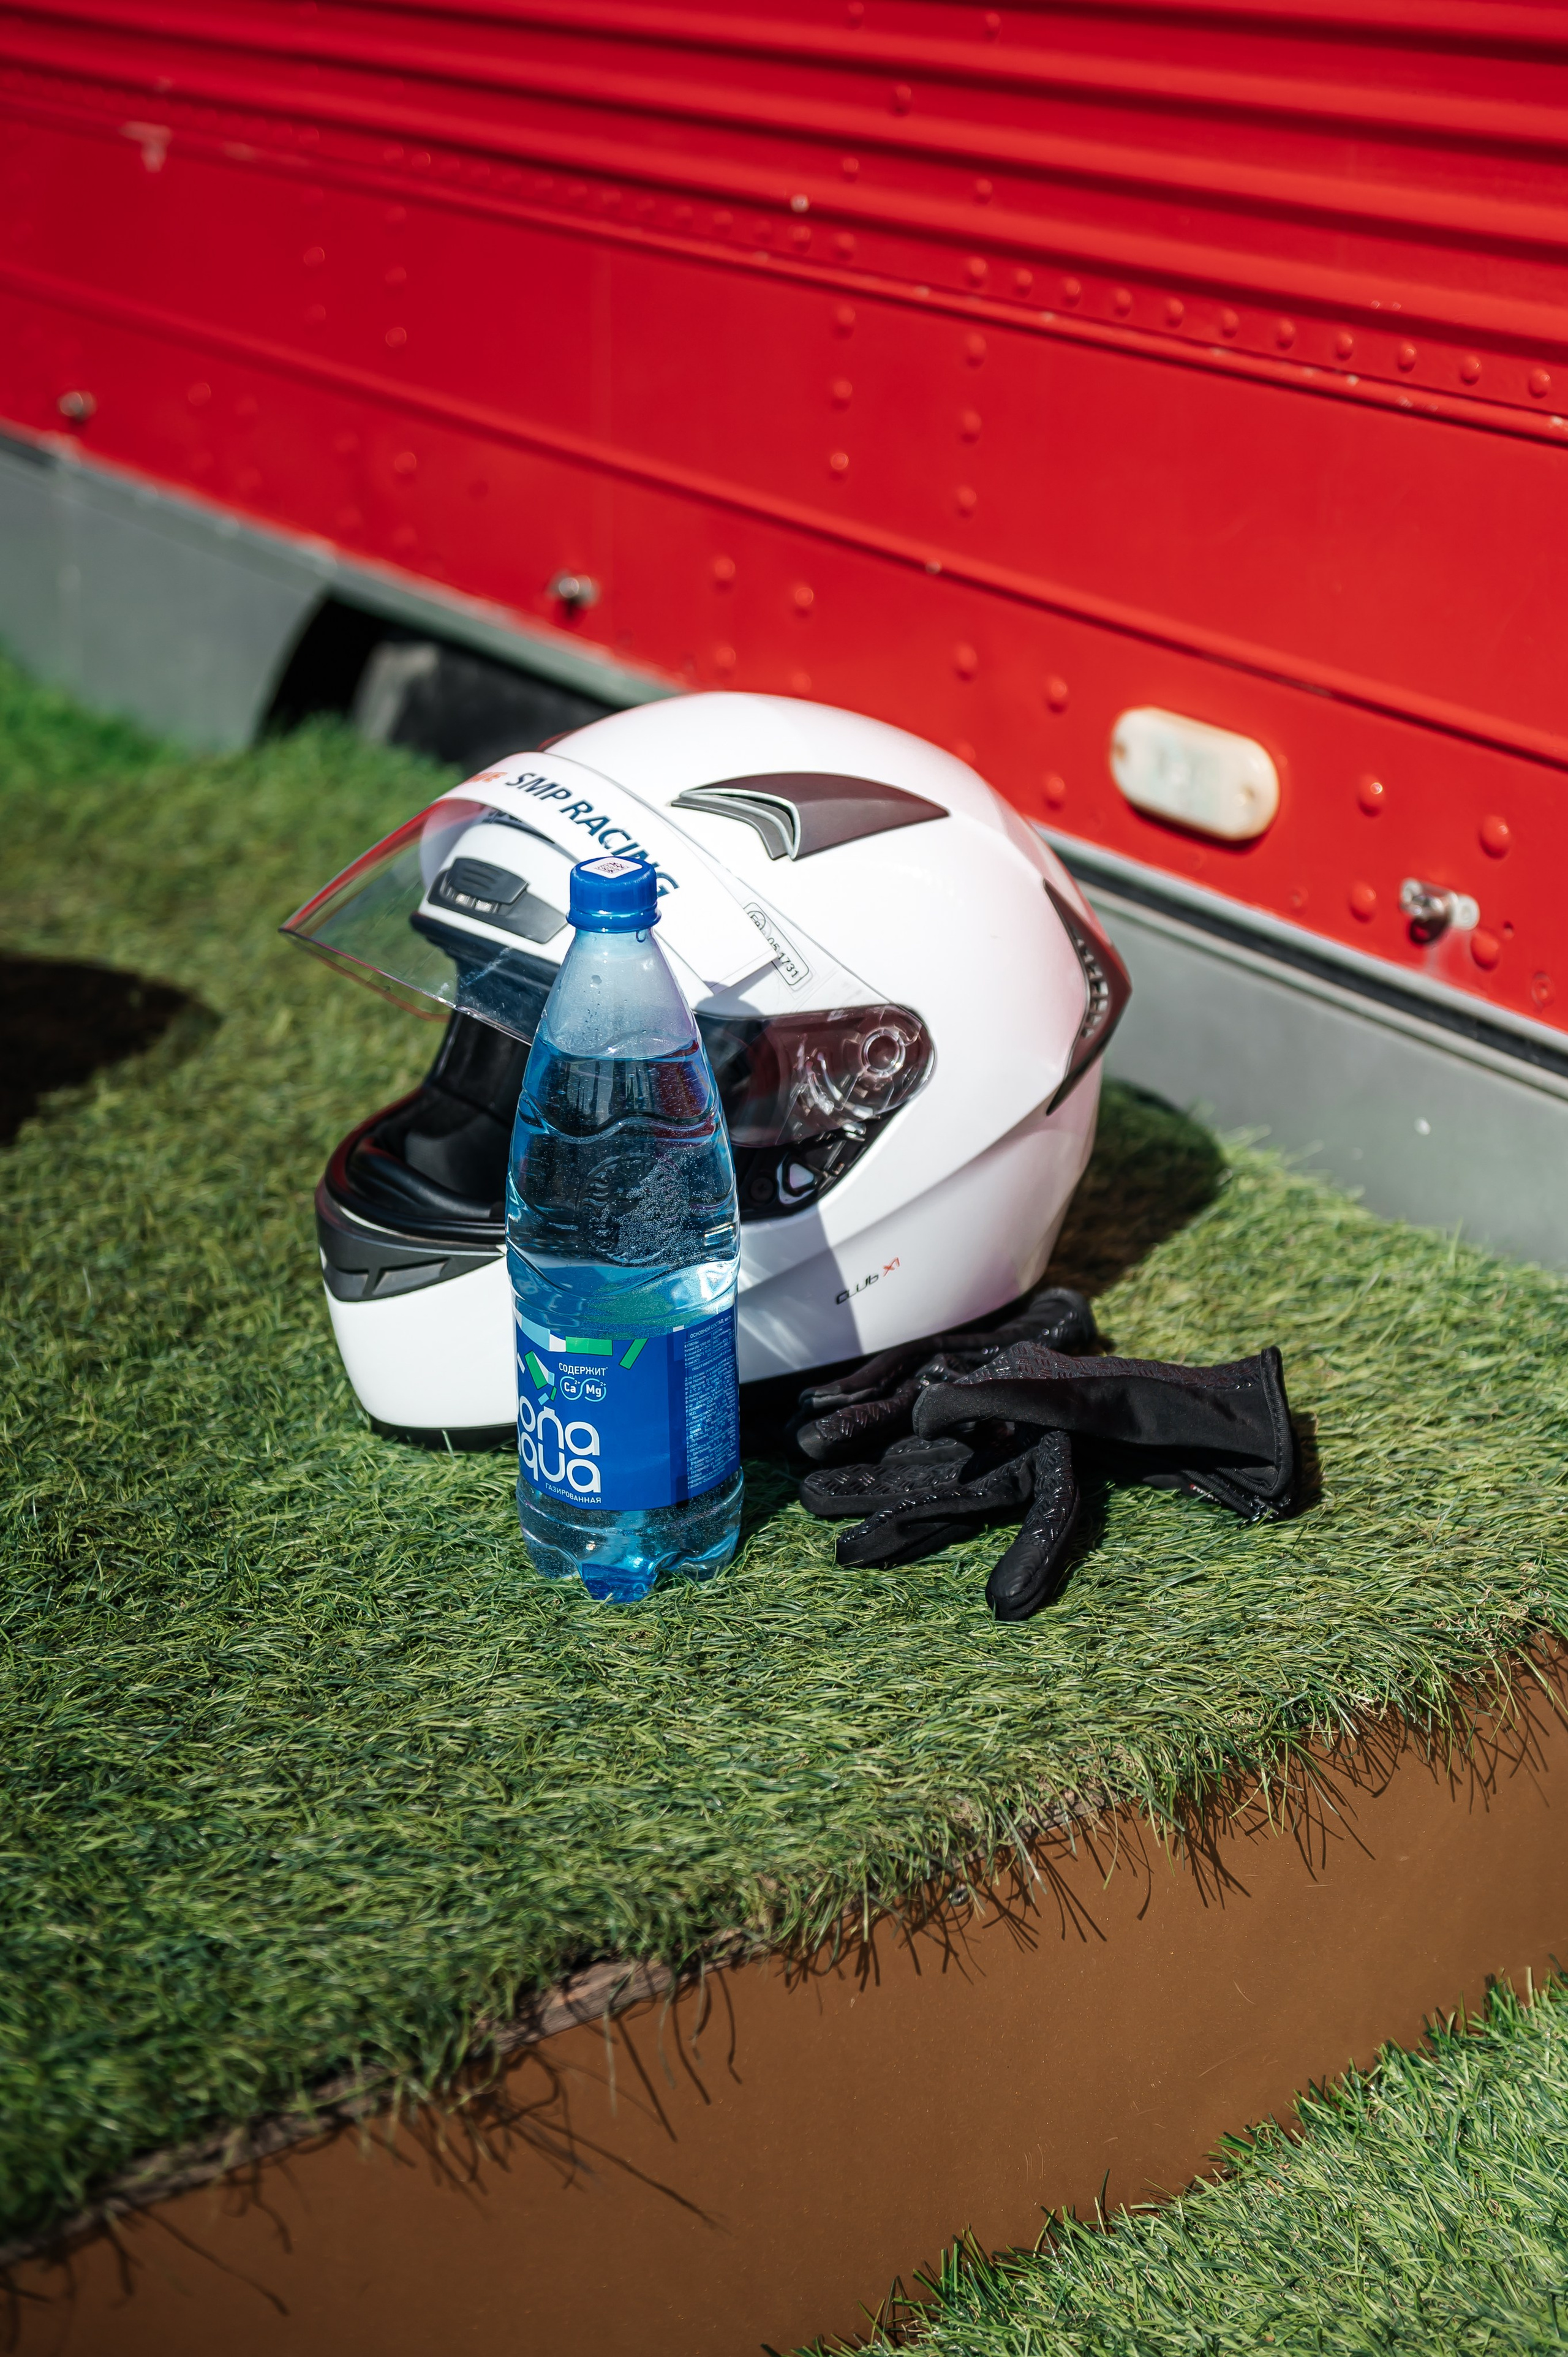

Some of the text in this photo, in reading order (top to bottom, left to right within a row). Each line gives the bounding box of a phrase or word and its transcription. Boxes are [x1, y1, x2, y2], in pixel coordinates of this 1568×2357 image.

[505, 771, 573, 801] SMP
[517, 1422, 601, 1493] qua
[545, 1482, 601, 1504] ГАЗИРОВАННАЯ
